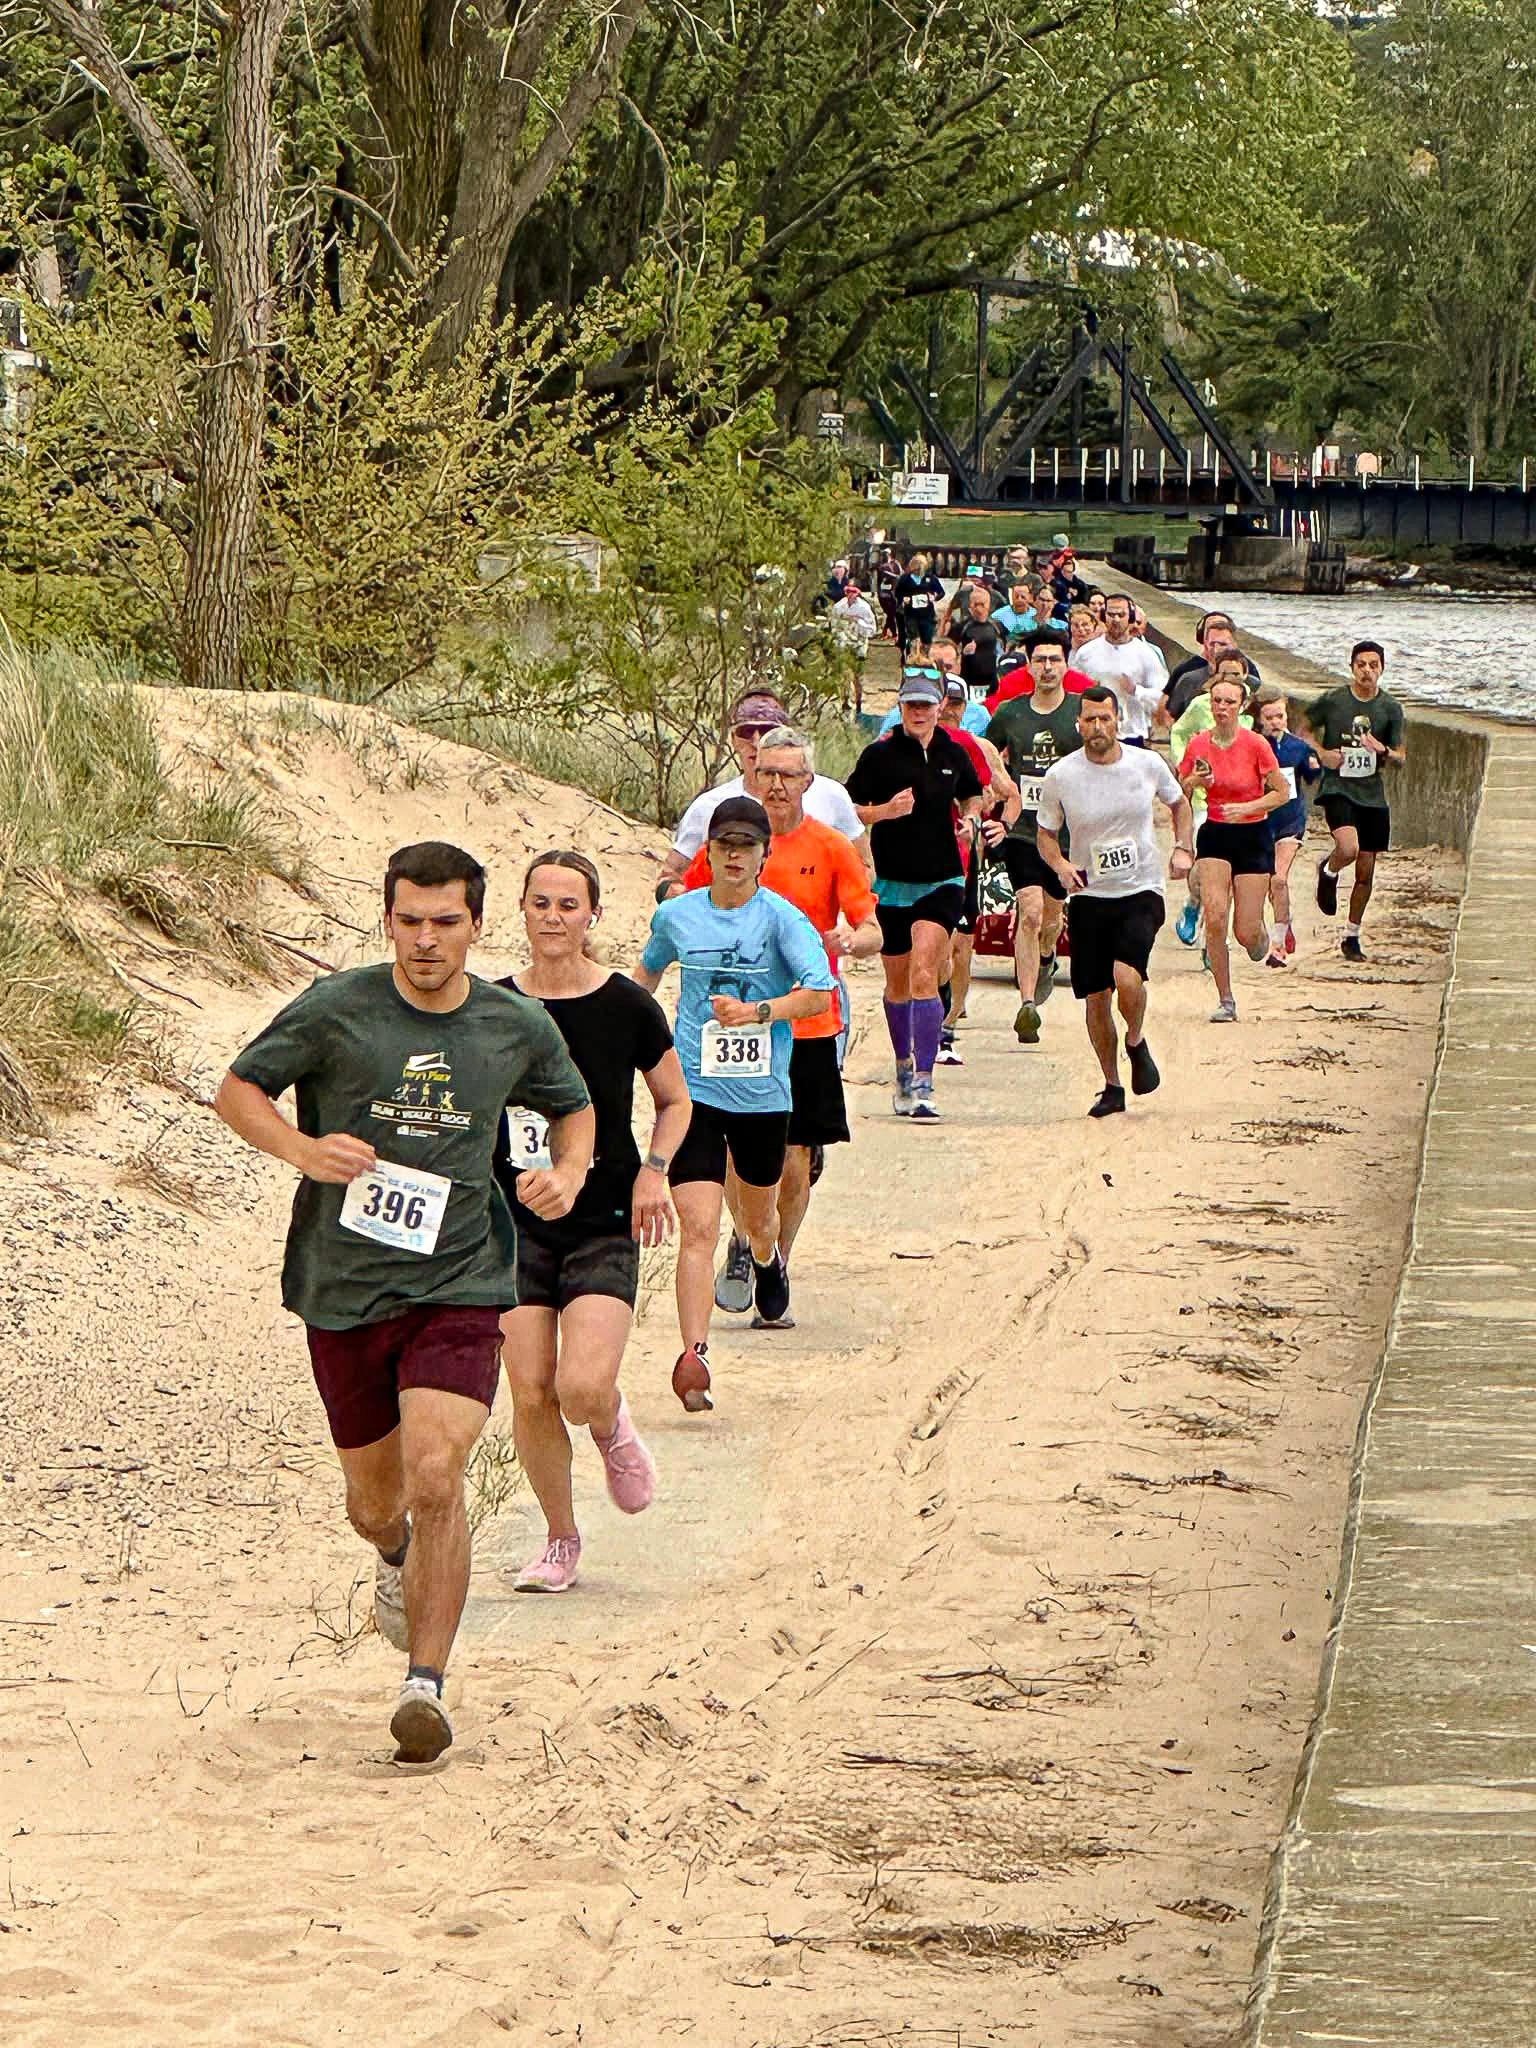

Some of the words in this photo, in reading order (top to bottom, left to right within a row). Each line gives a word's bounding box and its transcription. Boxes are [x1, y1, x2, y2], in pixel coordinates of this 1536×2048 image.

[1099, 848, 1130, 868] 285
[716, 1038, 760, 1063] 338
[363, 1183, 427, 1230] 396
